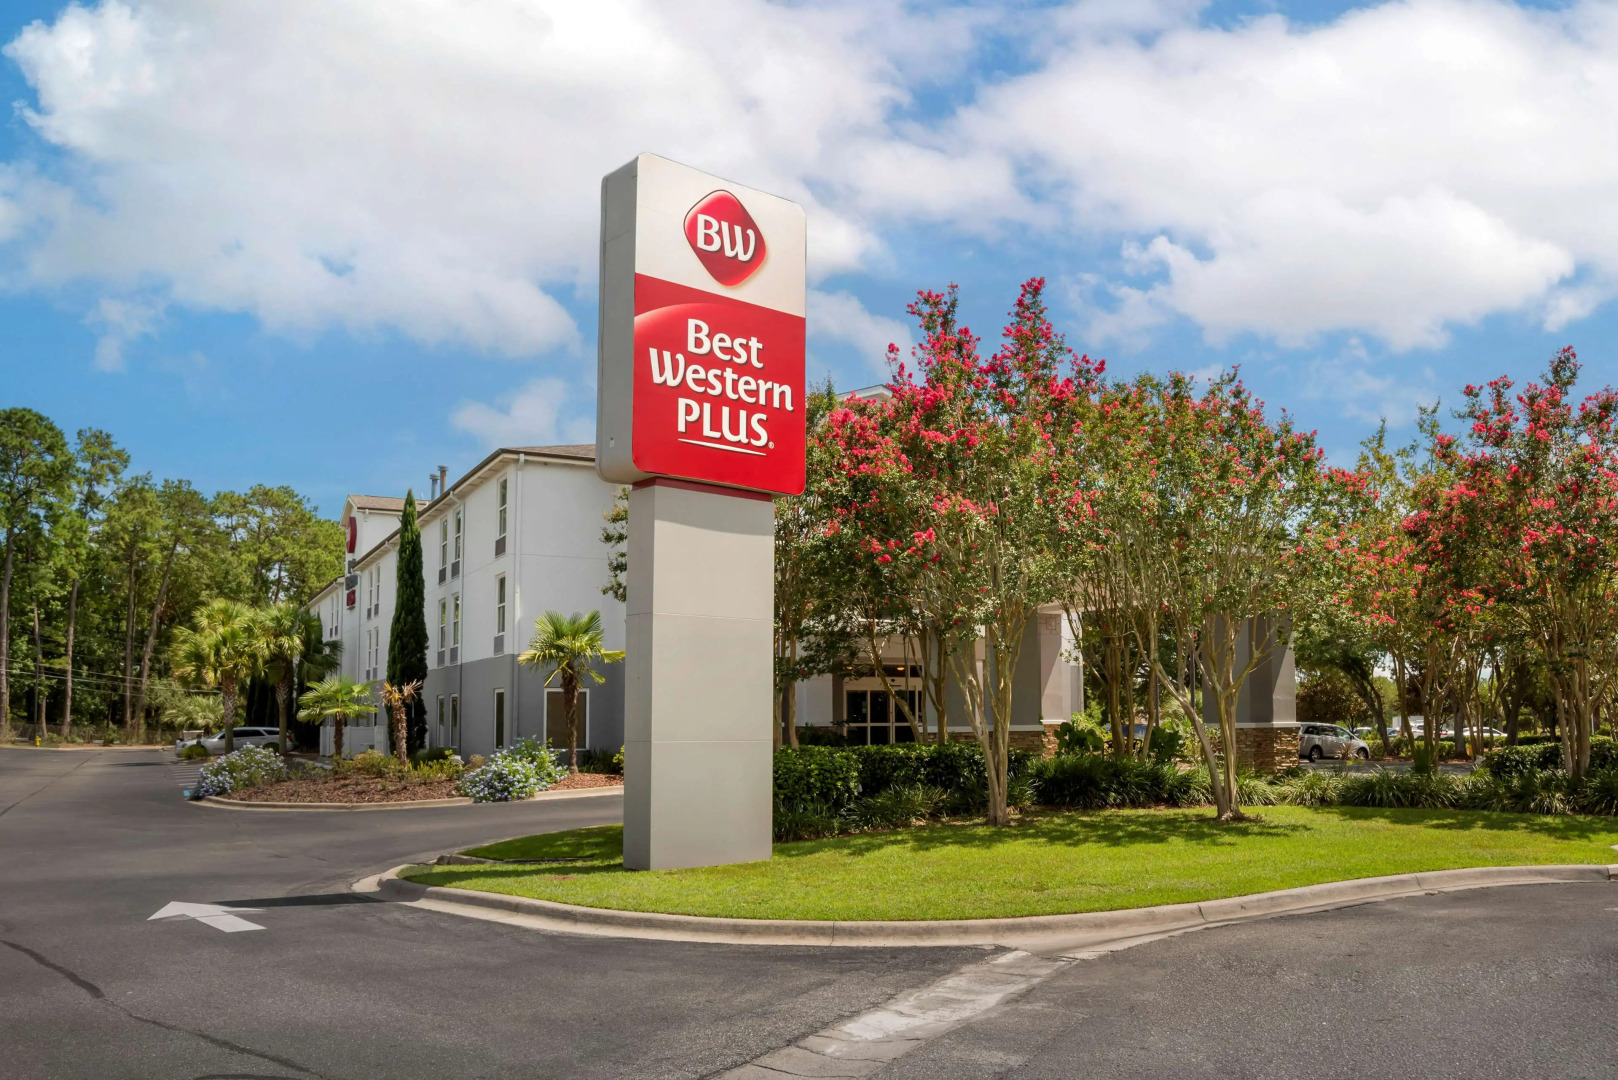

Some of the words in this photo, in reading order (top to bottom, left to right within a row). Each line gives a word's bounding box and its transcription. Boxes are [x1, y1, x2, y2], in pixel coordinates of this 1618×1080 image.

[697, 214, 755, 262] BW
[687, 318, 763, 368] Best
[649, 347, 793, 411] Western
